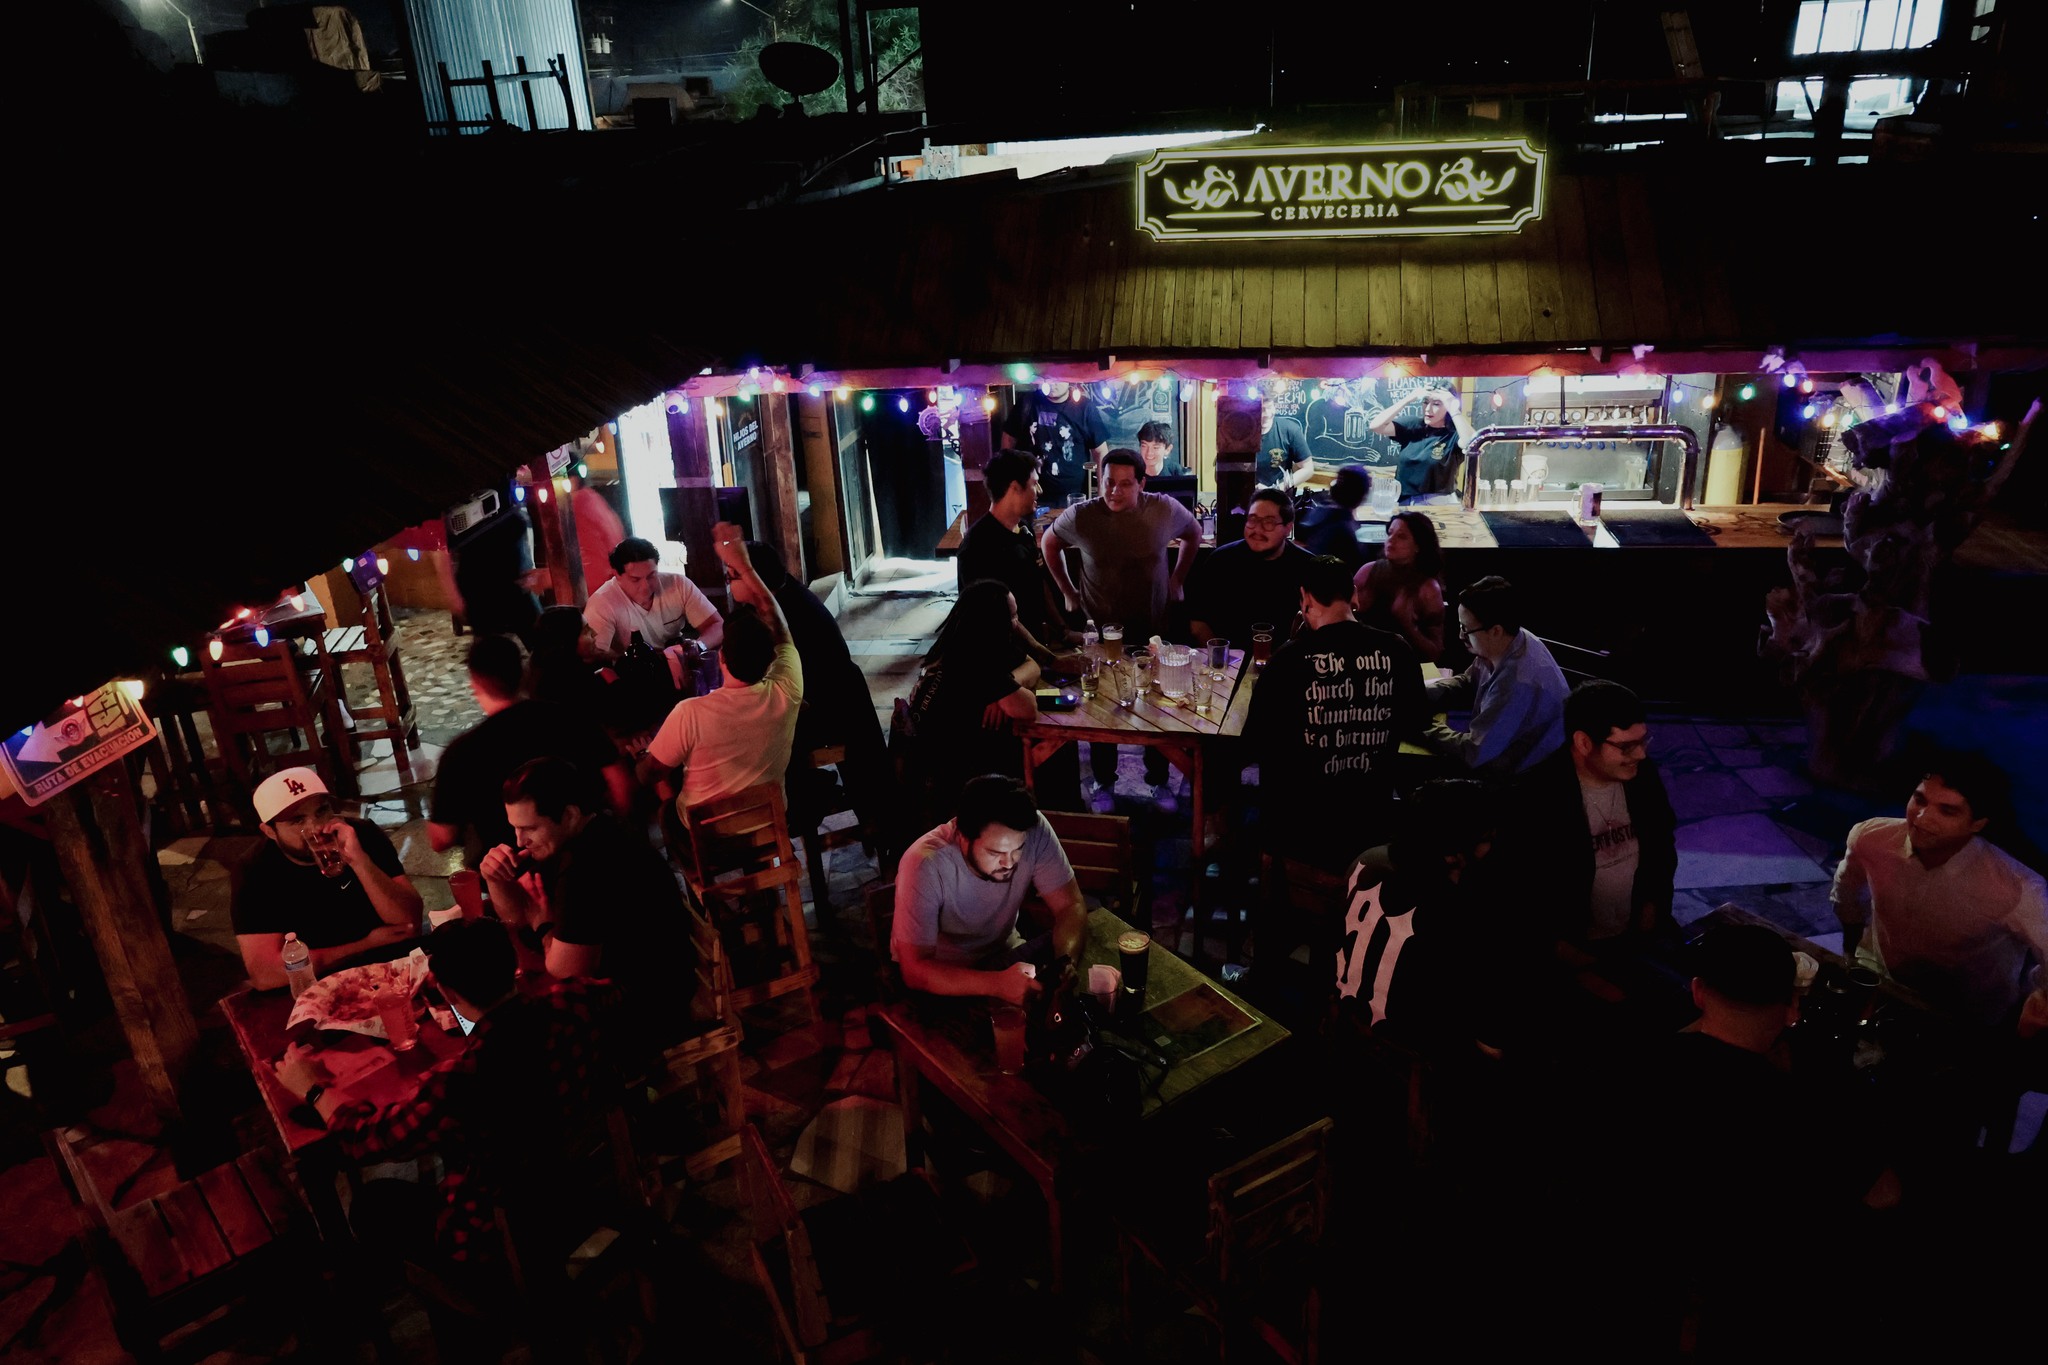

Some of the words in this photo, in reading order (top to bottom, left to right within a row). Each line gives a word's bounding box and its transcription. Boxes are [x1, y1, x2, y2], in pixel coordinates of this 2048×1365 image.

[1243, 160, 1431, 203] AVERNO
[1270, 204, 1400, 220] CERVECERIA
[1356, 649, 1392, 675] only
[1305, 677, 1354, 704] church
[1364, 675, 1394, 700] that
[1307, 703, 1392, 725] illuminates
[1303, 728, 1316, 746] is
[1319, 734, 1329, 749] a
[34, 772, 66, 795] RUTA
[64, 760, 82, 776] DE
[283, 778, 307, 796] LA
